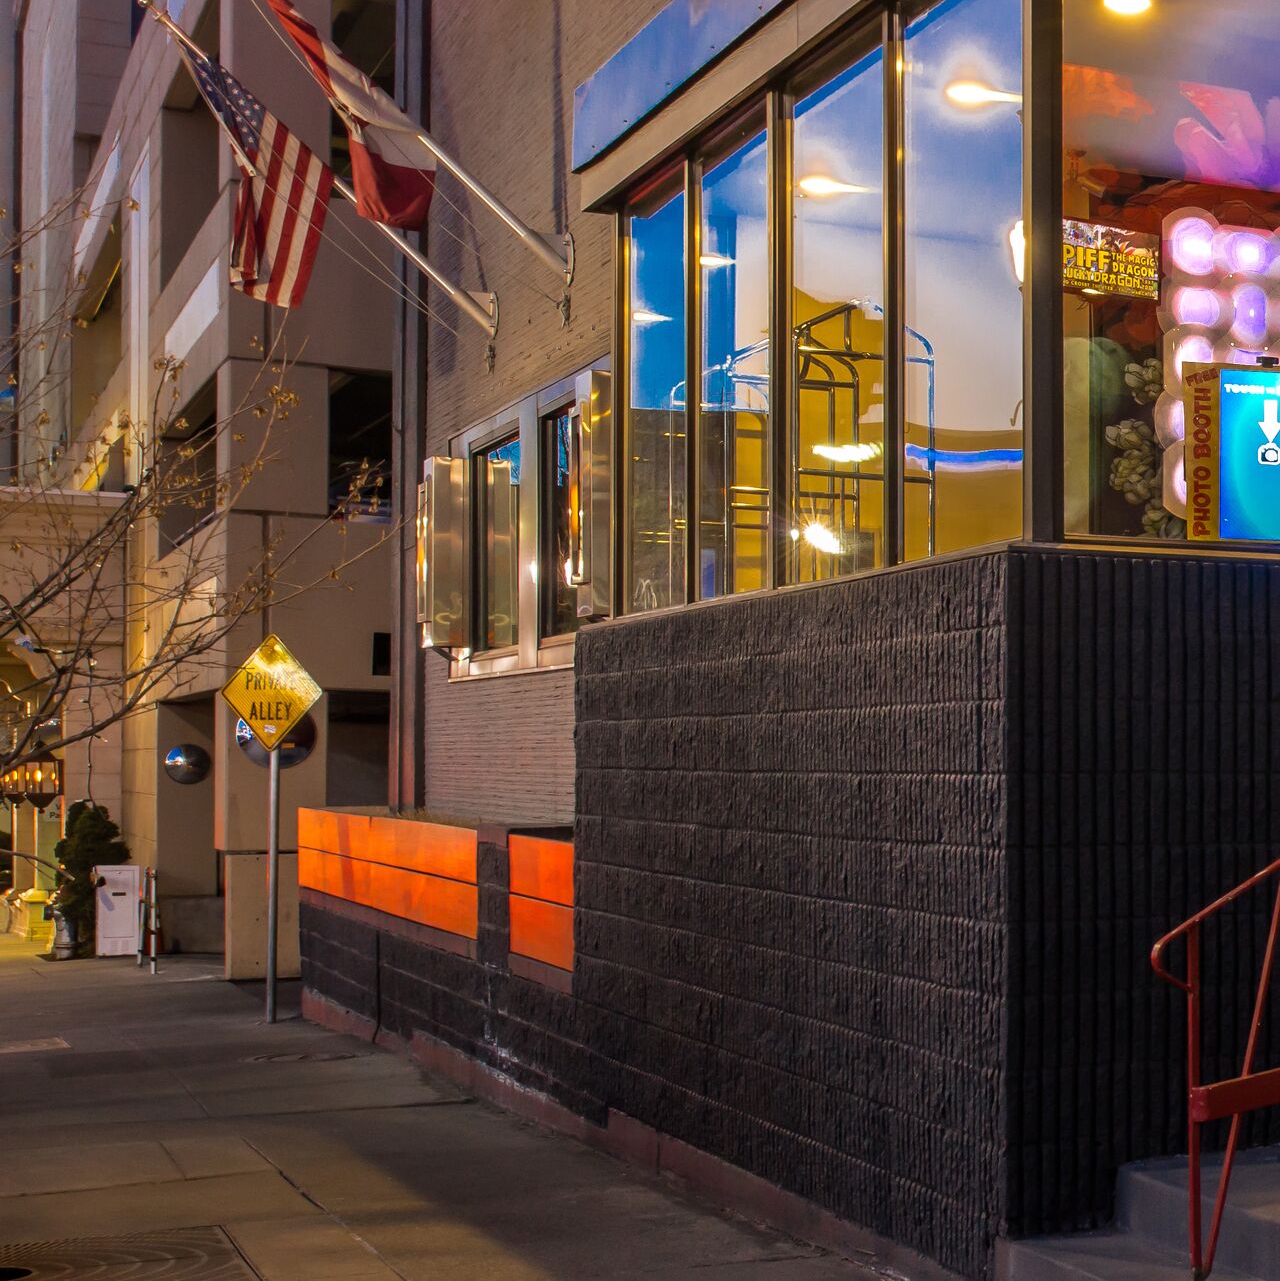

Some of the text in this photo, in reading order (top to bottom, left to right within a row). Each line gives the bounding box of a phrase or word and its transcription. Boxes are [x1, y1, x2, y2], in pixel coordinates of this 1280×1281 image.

[1063, 244, 1155, 270] PIFF THE MAGIC
[1113, 262, 1155, 278] DRAGON
[1186, 368, 1219, 386] FREE
[1193, 388, 1211, 537] PHOTO BOOTH
[249, 701, 292, 721] ALLEY
